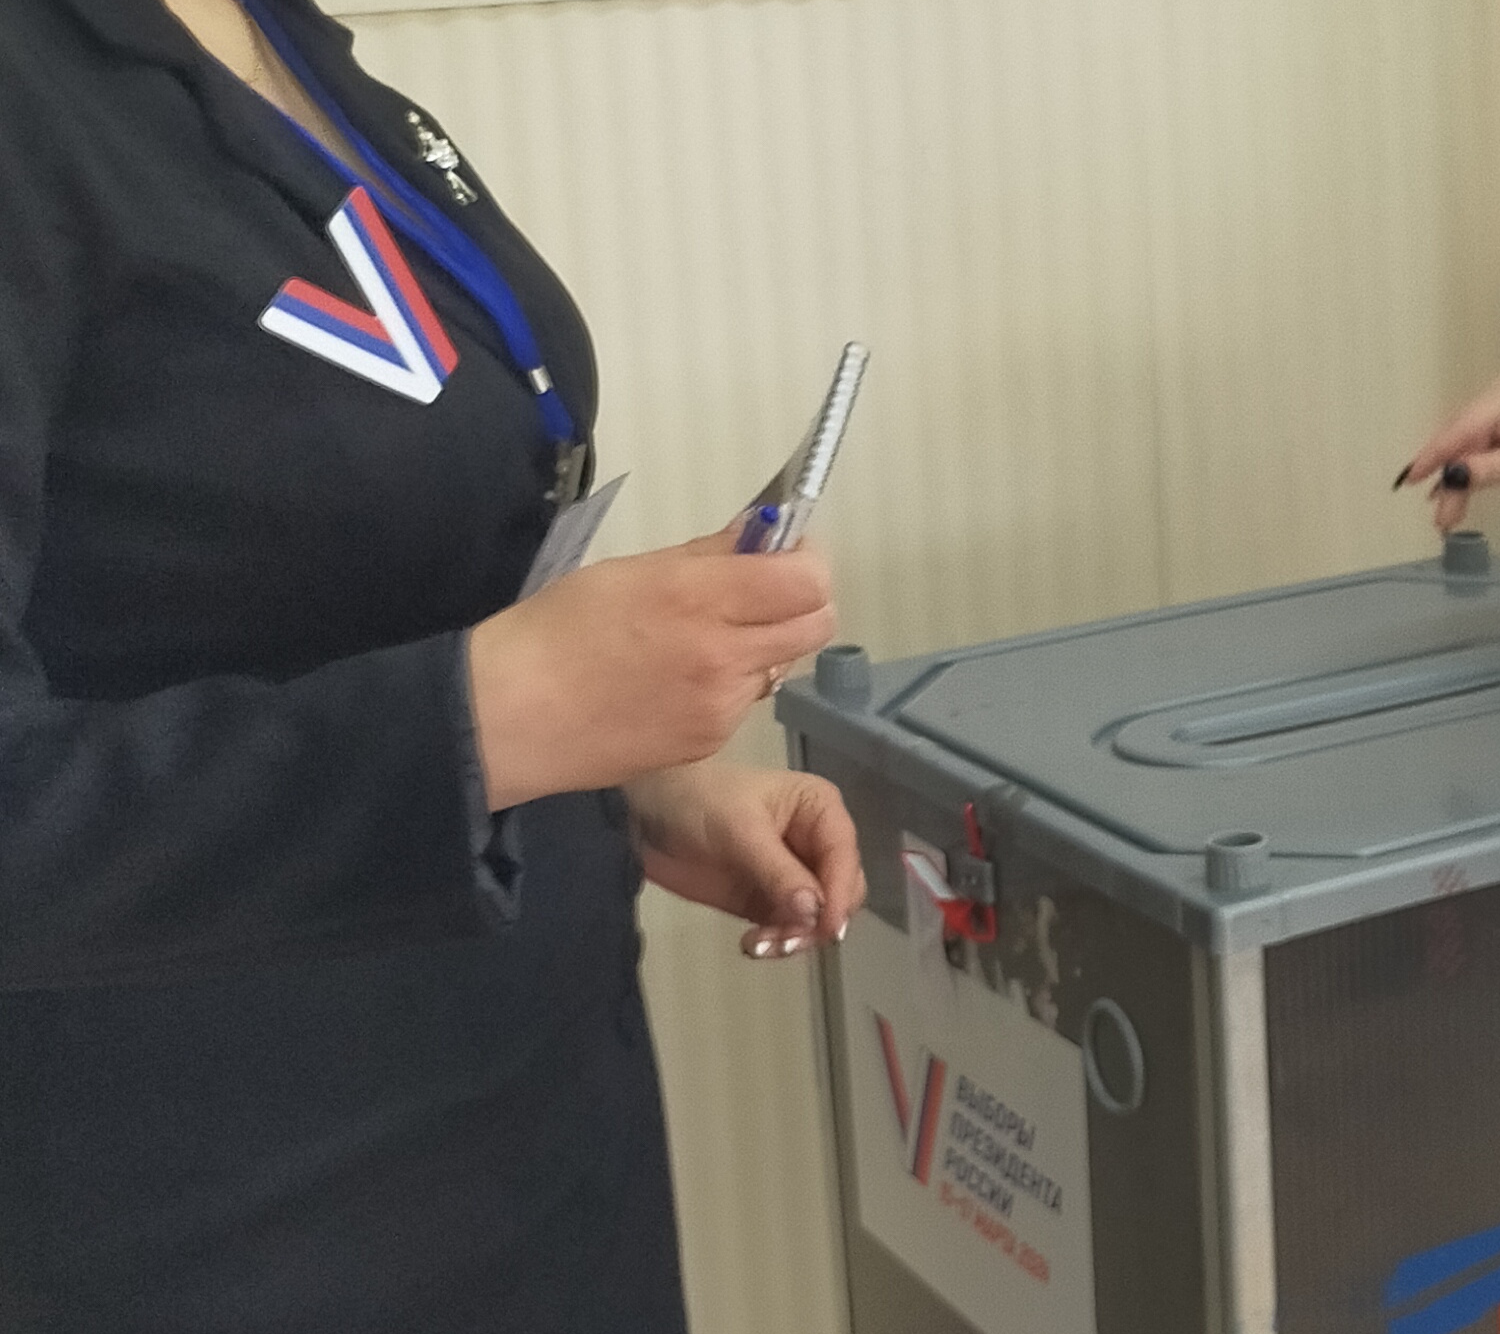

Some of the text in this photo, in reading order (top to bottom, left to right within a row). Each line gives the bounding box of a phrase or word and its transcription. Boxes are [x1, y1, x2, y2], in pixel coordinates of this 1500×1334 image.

[955, 1074, 1036, 1151] ВЫБОРЫ
[944, 1149, 1014, 1219] РОССИИ
[949, 1111, 1064, 1215] ПРЕЗИДЕНТА
